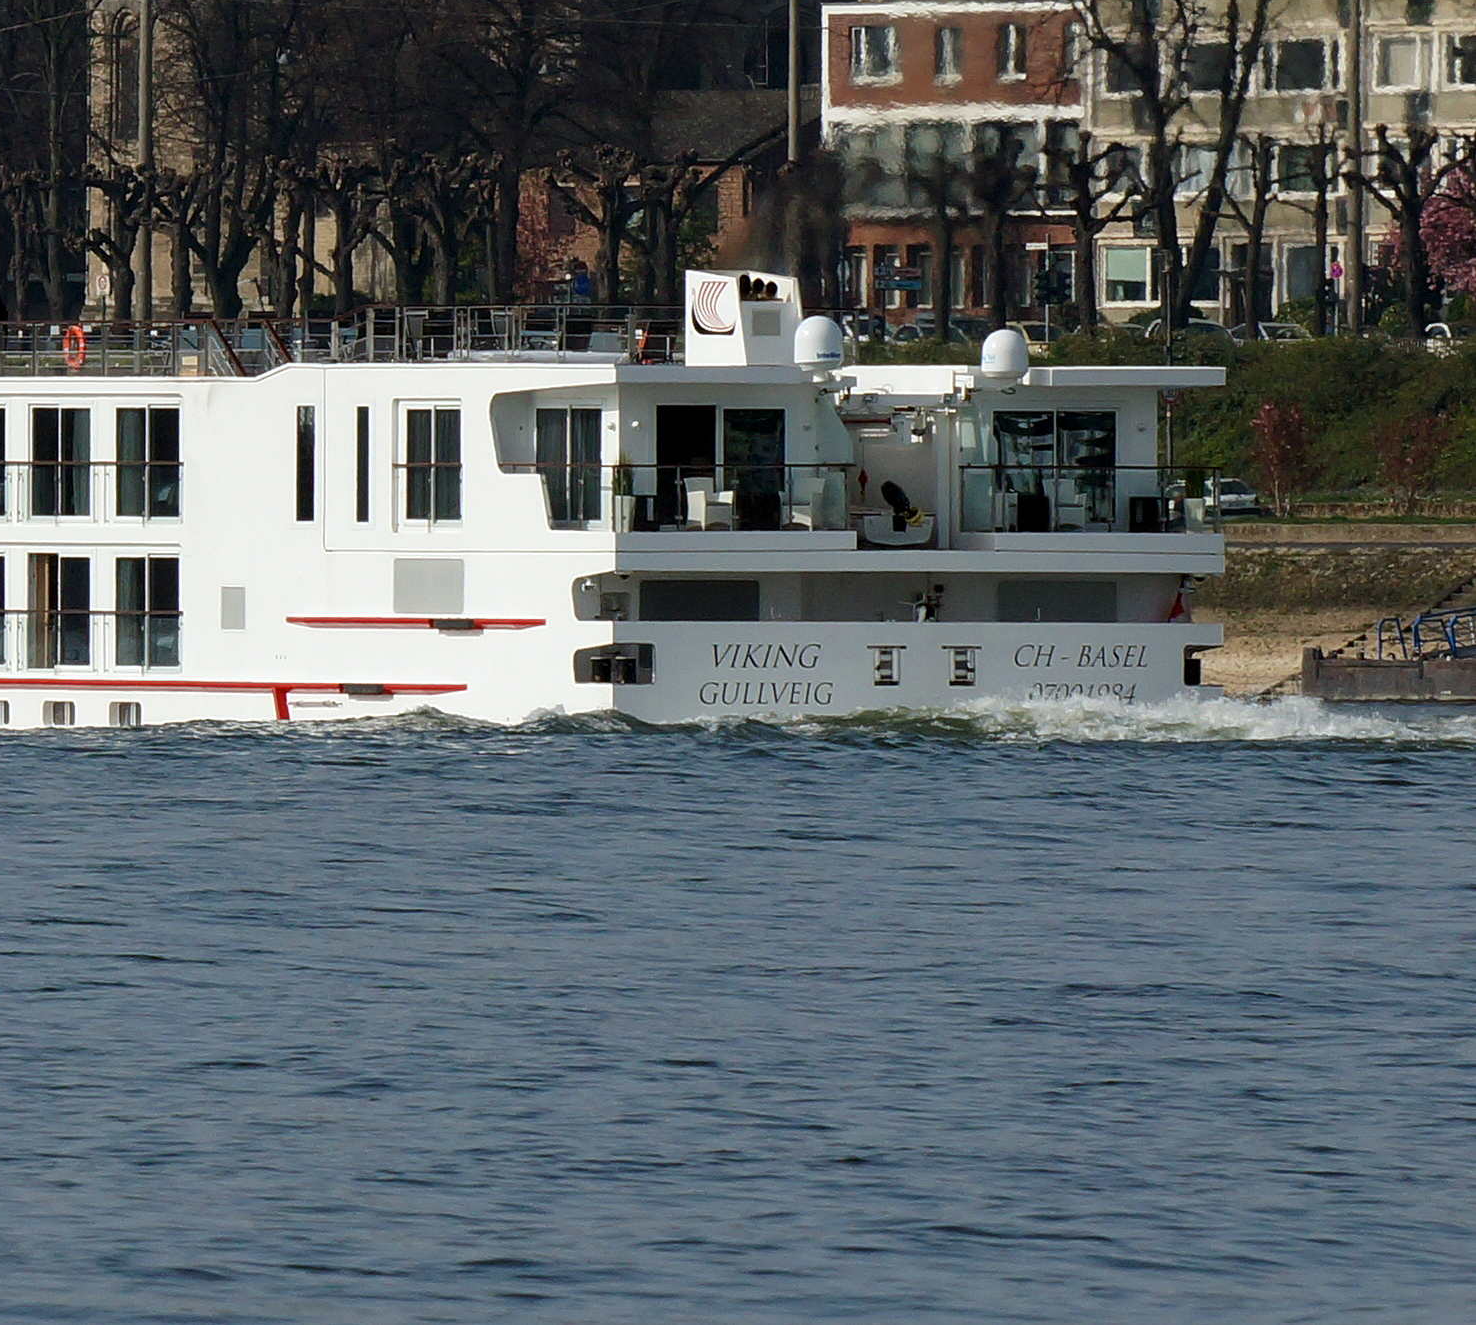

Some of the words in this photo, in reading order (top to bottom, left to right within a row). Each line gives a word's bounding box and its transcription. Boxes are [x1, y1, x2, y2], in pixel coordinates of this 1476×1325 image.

[712, 643, 822, 669] VIKING
[1014, 644, 1056, 668] CH
[1077, 644, 1148, 668] BASEL
[699, 681, 834, 706] GULLVEIG
